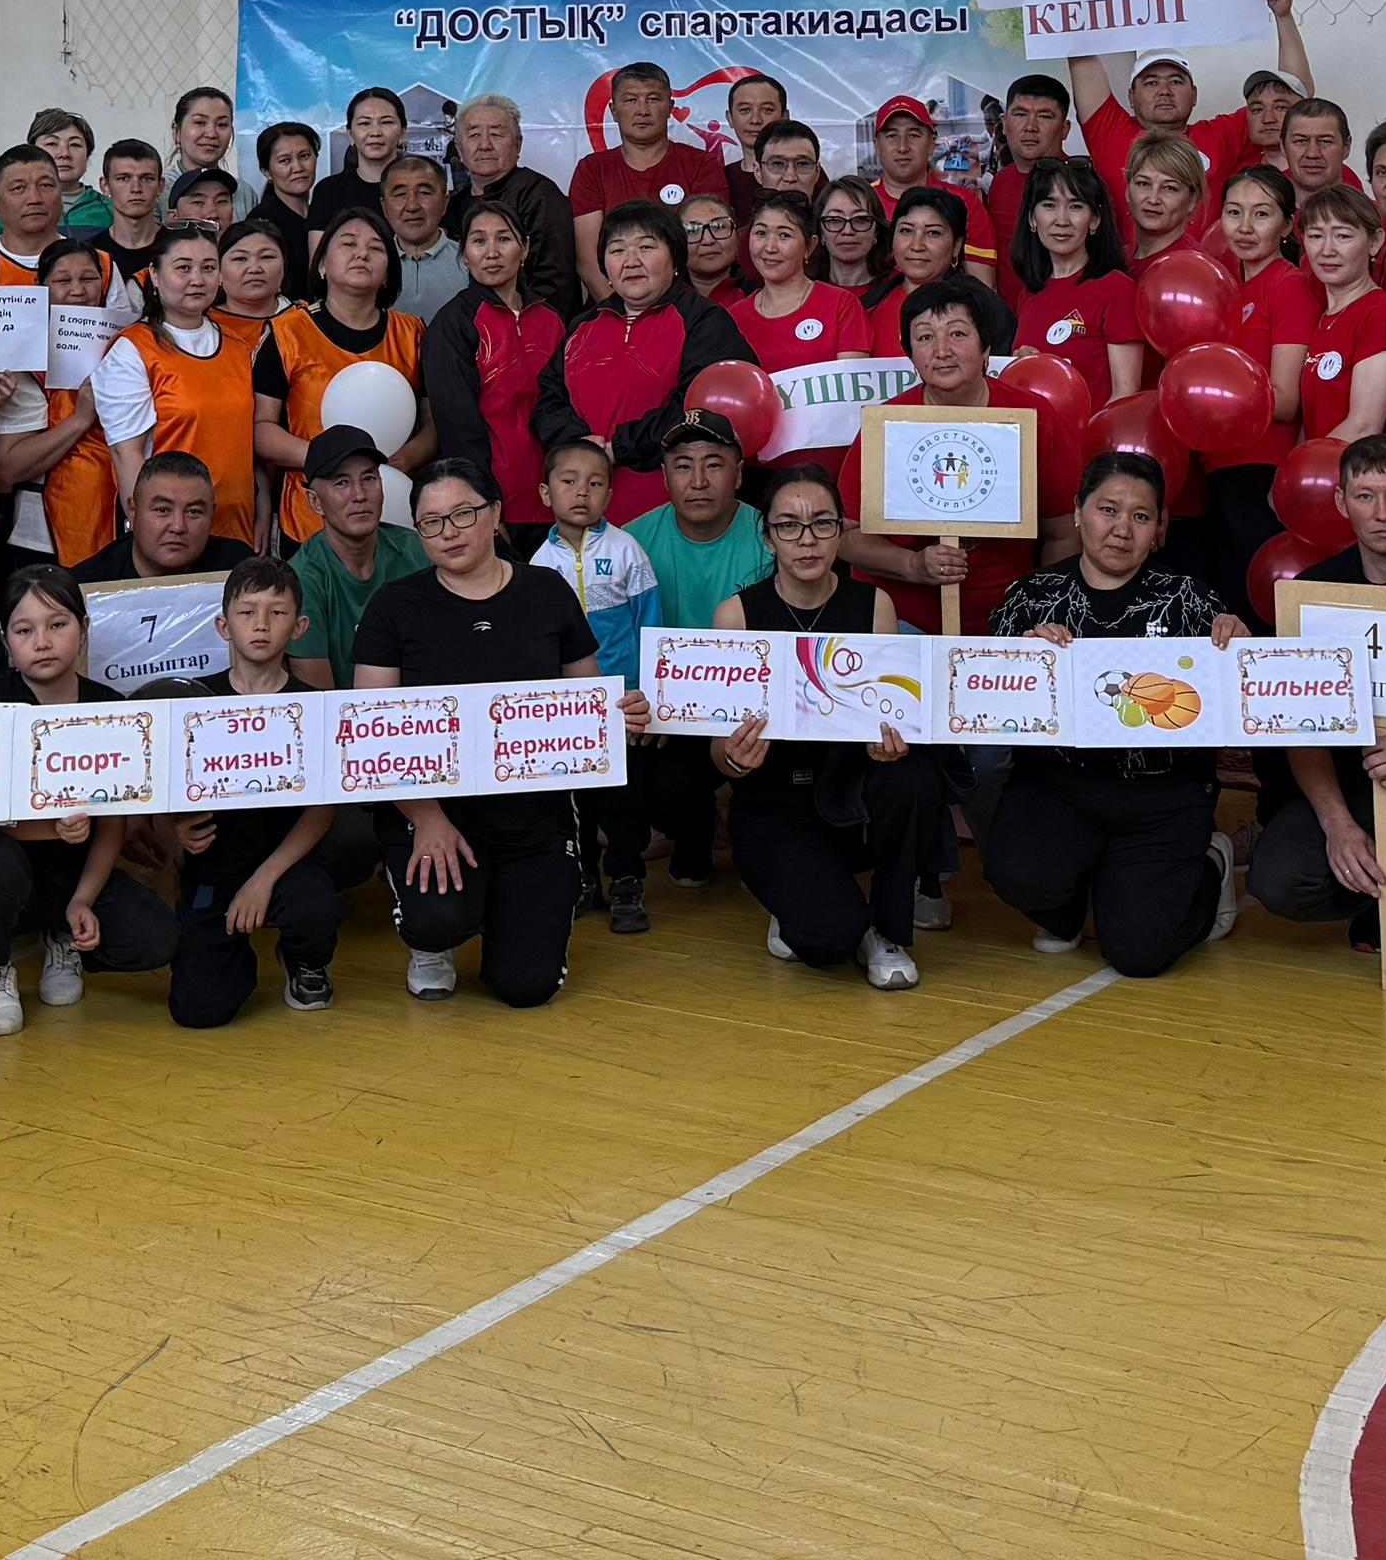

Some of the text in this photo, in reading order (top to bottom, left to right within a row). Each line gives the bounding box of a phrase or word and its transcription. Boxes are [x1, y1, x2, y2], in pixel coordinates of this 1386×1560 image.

[639, 7, 968, 44] спартакиадасы
[68, 317, 97, 326] спорте
[594, 558, 613, 576] KZ
[140, 614, 157, 643] 7
[1364, 622, 1383, 660] 4
[104, 653, 210, 680] Сыныптар
[655, 658, 1349, 697] Быстрее выше сильнее
[227, 716, 266, 734] это
[336, 715, 460, 744] Добьёмся
[203, 744, 292, 773] жизнь!
[494, 727, 606, 761] держись!
[45, 751, 131, 775] Спорт-
[346, 747, 452, 776] победы!
